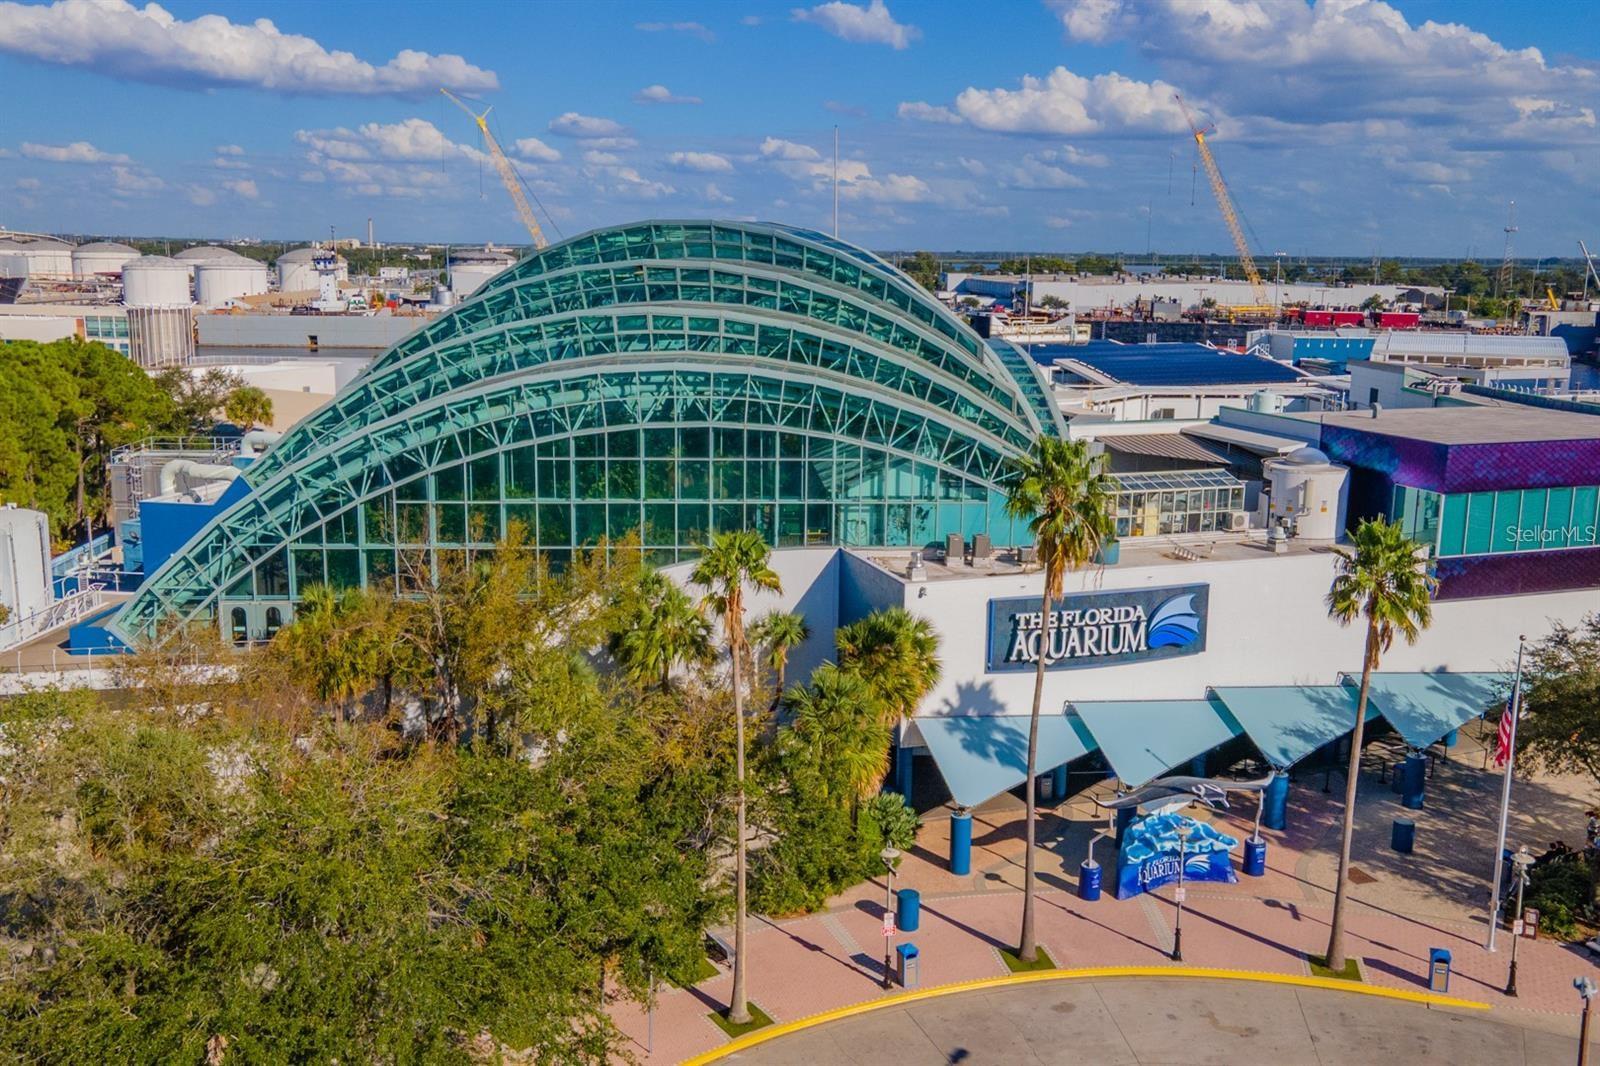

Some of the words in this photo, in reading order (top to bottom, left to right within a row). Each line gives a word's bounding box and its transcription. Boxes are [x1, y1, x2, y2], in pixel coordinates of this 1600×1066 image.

[1015, 611, 1059, 630] THE
[1062, 605, 1147, 627] FLORIDA
[1010, 621, 1147, 665] AQUARIUM
